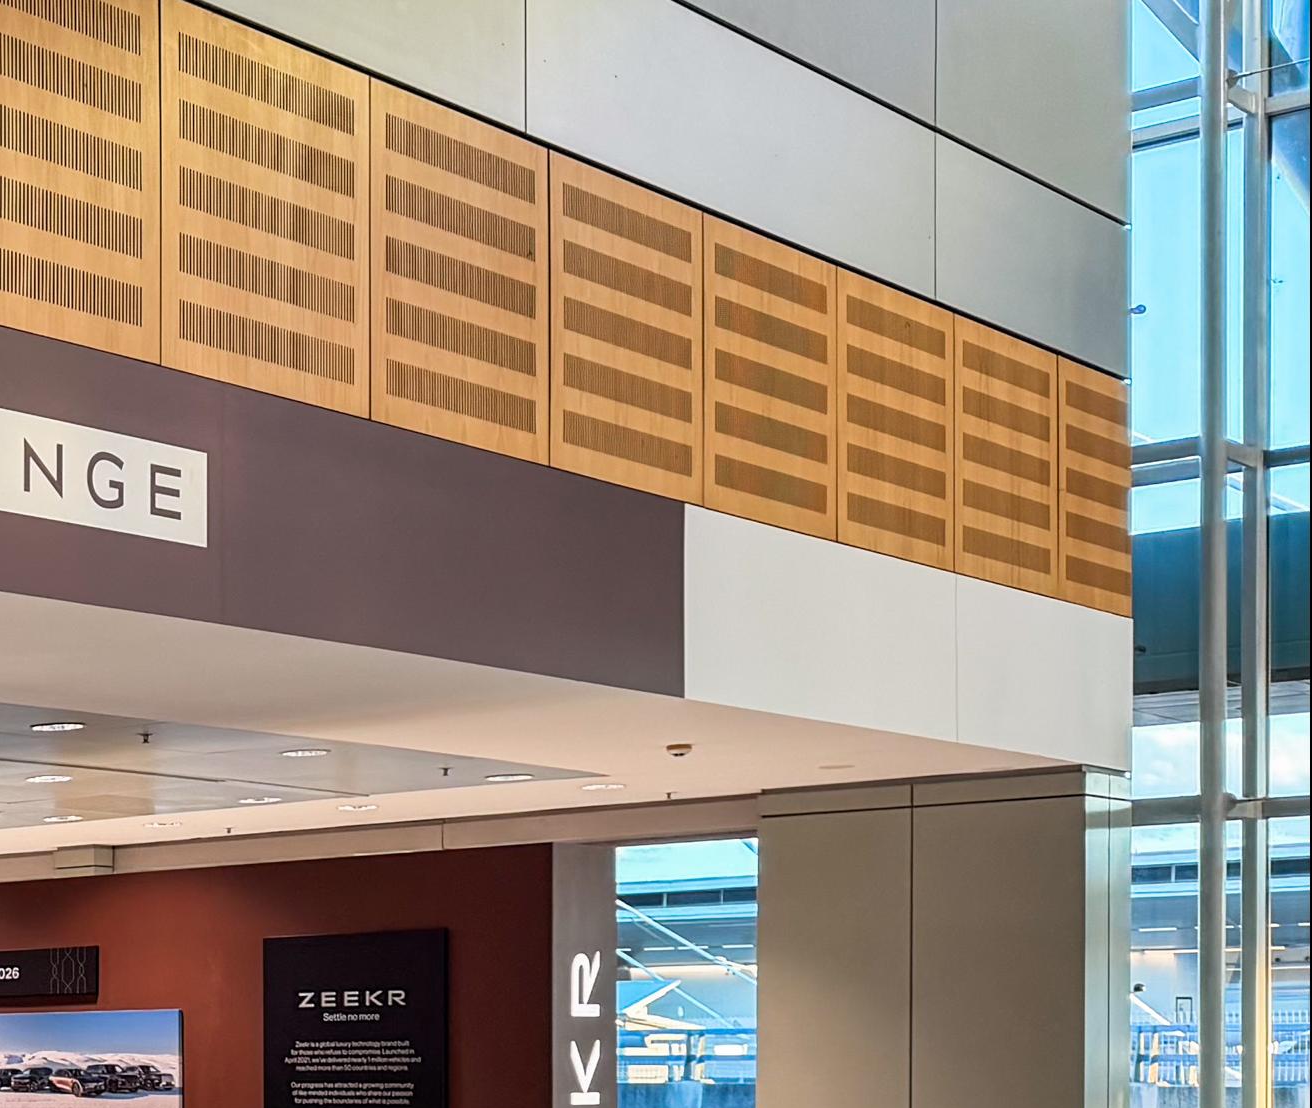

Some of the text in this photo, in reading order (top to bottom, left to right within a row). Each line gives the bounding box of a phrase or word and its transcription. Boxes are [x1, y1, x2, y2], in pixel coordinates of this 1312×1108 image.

[298, 990, 406, 1008] ZEEKR
[323, 1012, 347, 1022] Settle
[359, 1013, 380, 1021] more
